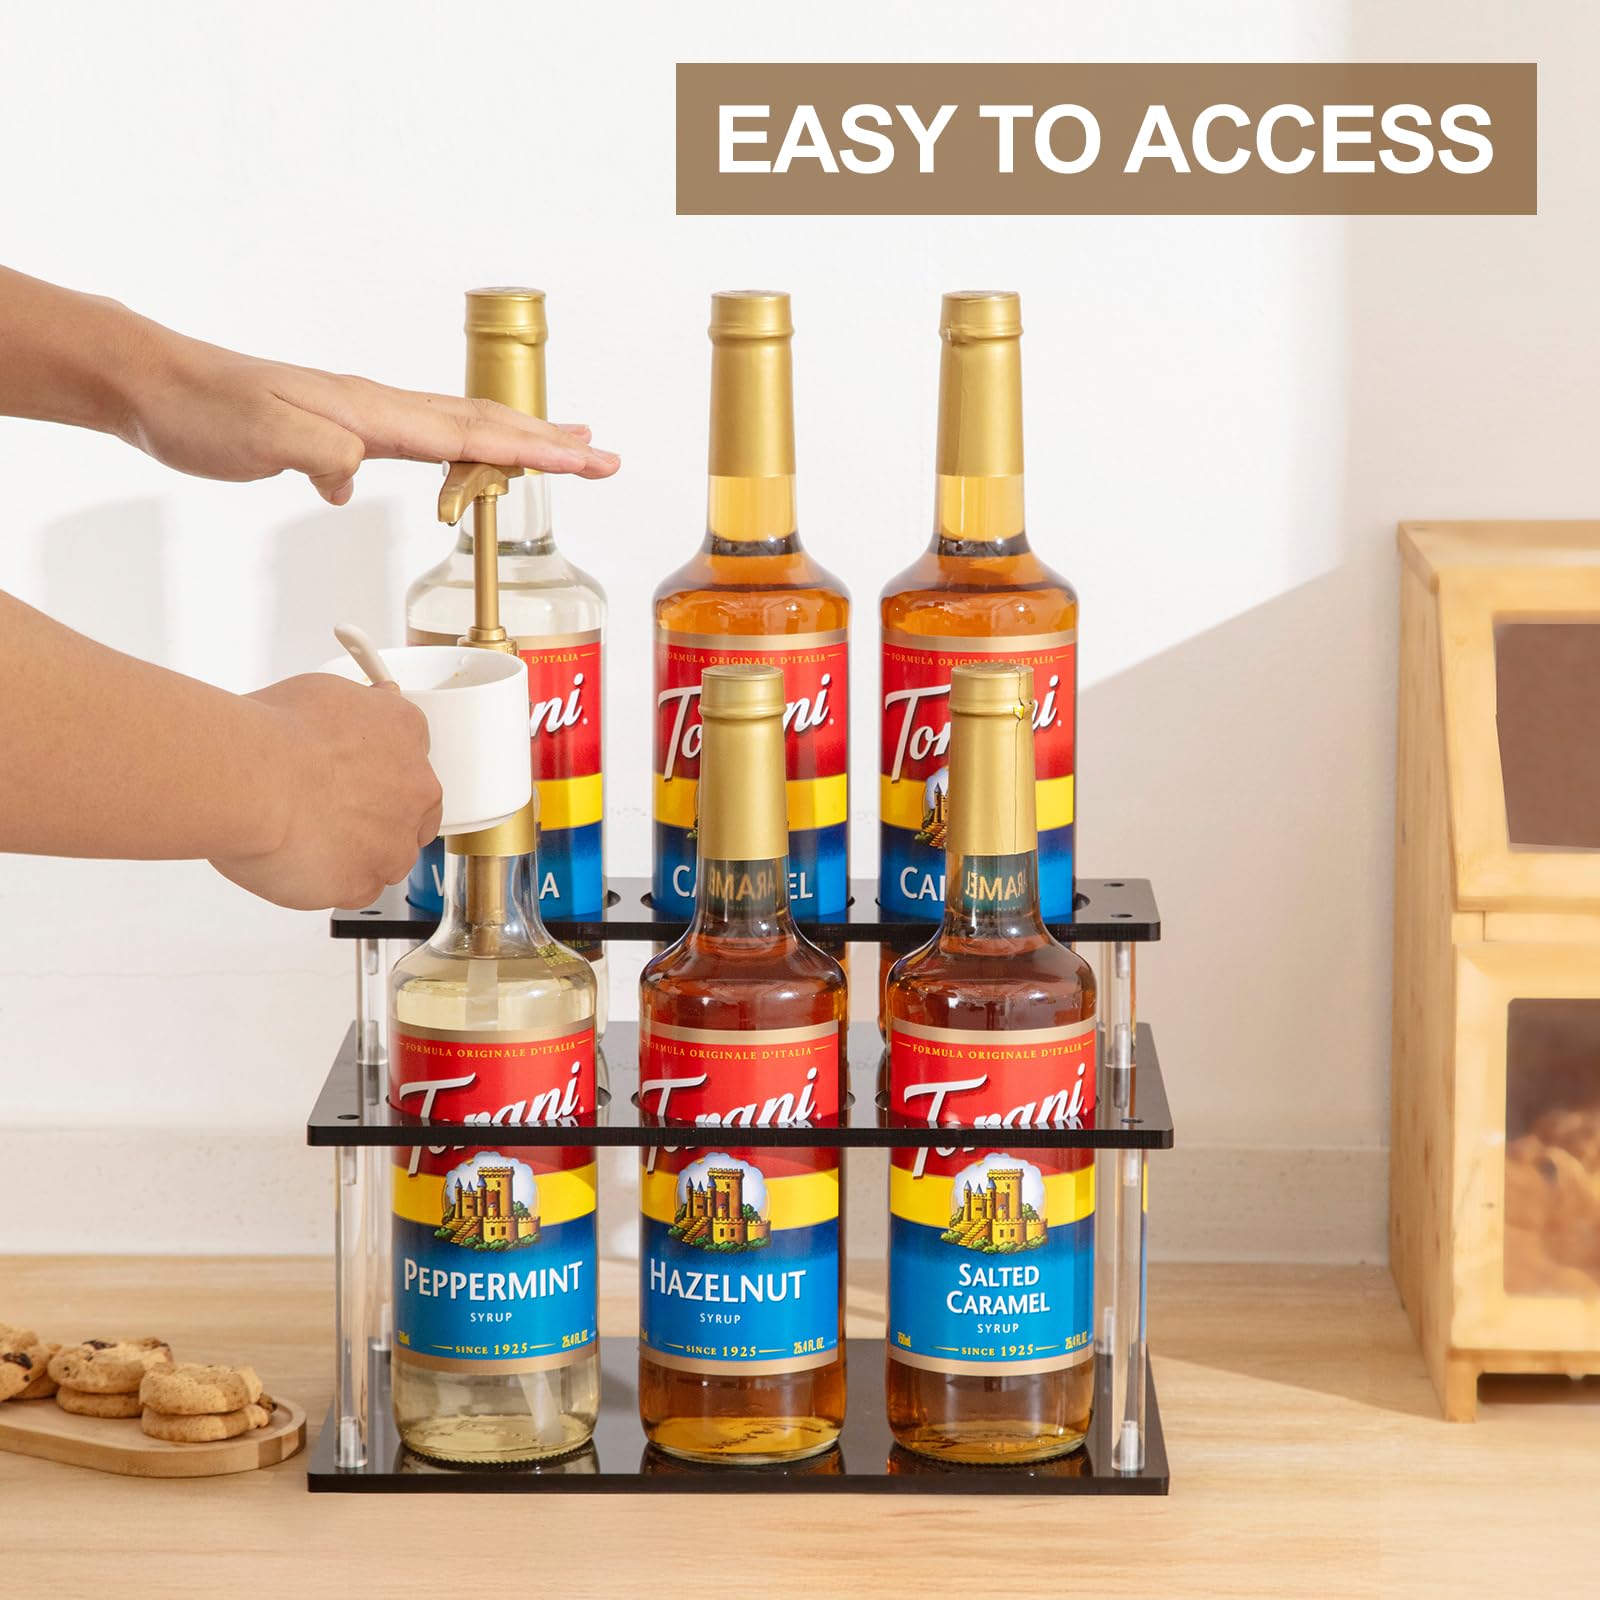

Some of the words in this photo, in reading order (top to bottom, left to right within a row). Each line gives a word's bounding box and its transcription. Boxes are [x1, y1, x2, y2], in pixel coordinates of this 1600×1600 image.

[531, 653, 578, 664] D'ITALIA
[709, 655, 776, 665] ORIGINALE
[780, 653, 826, 665] D'ITALIA
[891, 652, 934, 665] FORMULA
[657, 673, 834, 782] Toni
[884, 674, 1062, 784] Tori
[405, 1042, 452, 1057] FORMULA
[457, 1049, 526, 1058] ORIGINALE
[530, 1042, 576, 1056] D'ITALIA
[689, 1050, 757, 1060] ORIGINALE
[762, 1047, 812, 1060] D'ITALIA
[912, 1043, 963, 1059] FORMULA
[968, 1050, 1036, 1060] ORIGINALE
[1041, 1043, 1082, 1057] D'ITALIA
[404, 1257, 583, 1301] PEPPERMINT
[650, 1257, 807, 1303] HAZELNUT
[958, 1263, 1040, 1287] SALTED
[946, 1290, 1050, 1315] CARAMEL
[470, 1312, 513, 1323] SYRUP
[699, 1312, 741, 1325] SYRUP
[977, 1323, 1020, 1334] SYRUP
[455, 1345, 488, 1354] SINCE
[494, 1343, 528, 1355] 1925
[686, 1344, 717, 1355] SINCE
[722, 1346, 757, 1357] 1925
[962, 1347, 995, 1356] SINCE
[1000, 1344, 1034, 1356] 1925
